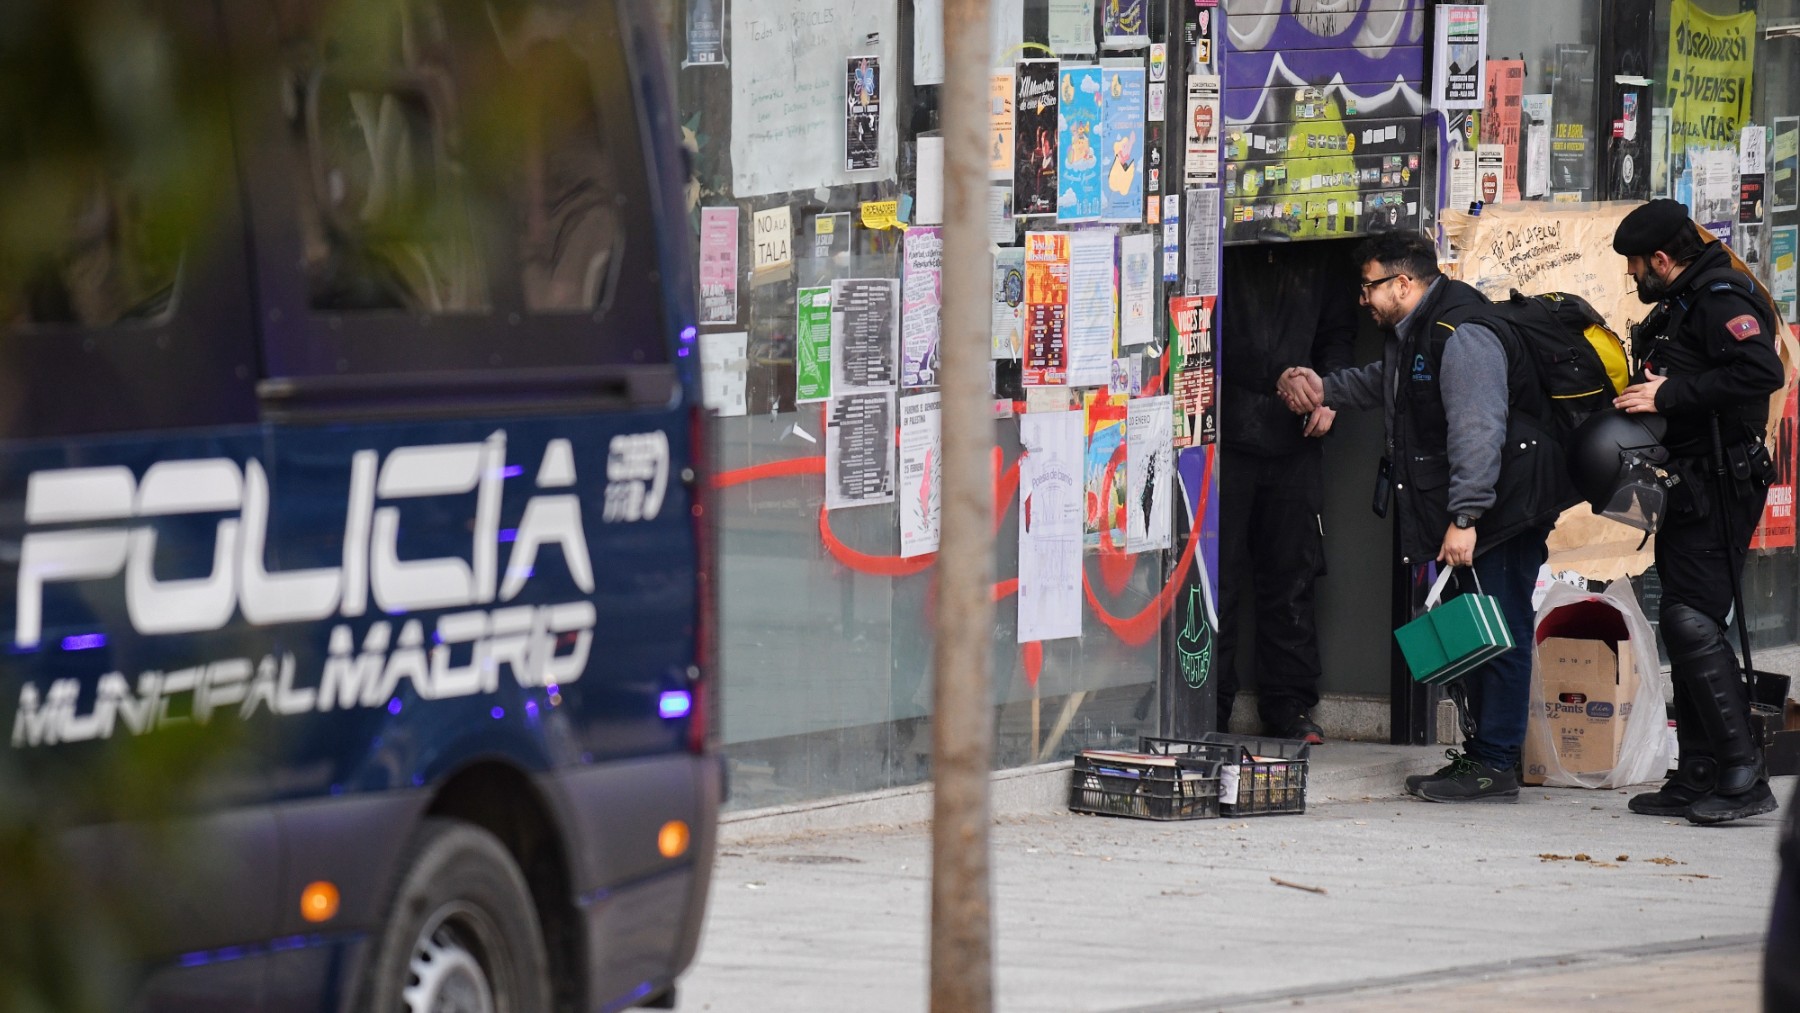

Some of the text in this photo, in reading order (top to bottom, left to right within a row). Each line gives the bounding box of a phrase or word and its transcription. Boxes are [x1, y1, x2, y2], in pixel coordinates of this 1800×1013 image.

[758, 215, 773, 234] NO
[758, 240, 788, 264] TALA
[1178, 307, 1211, 332] VOCES POR
[1178, 331, 1211, 356] PALESTINA
[1135, 415, 1150, 425] ENERO
[1050, 467, 1058, 480] de
[1058, 468, 1073, 487] barrio
[1767, 486, 1792, 505] GUERRAS
[318, 601, 596, 713] MADRID
[1554, 703, 1583, 713] Pants
[1529, 764, 1546, 776] 80
